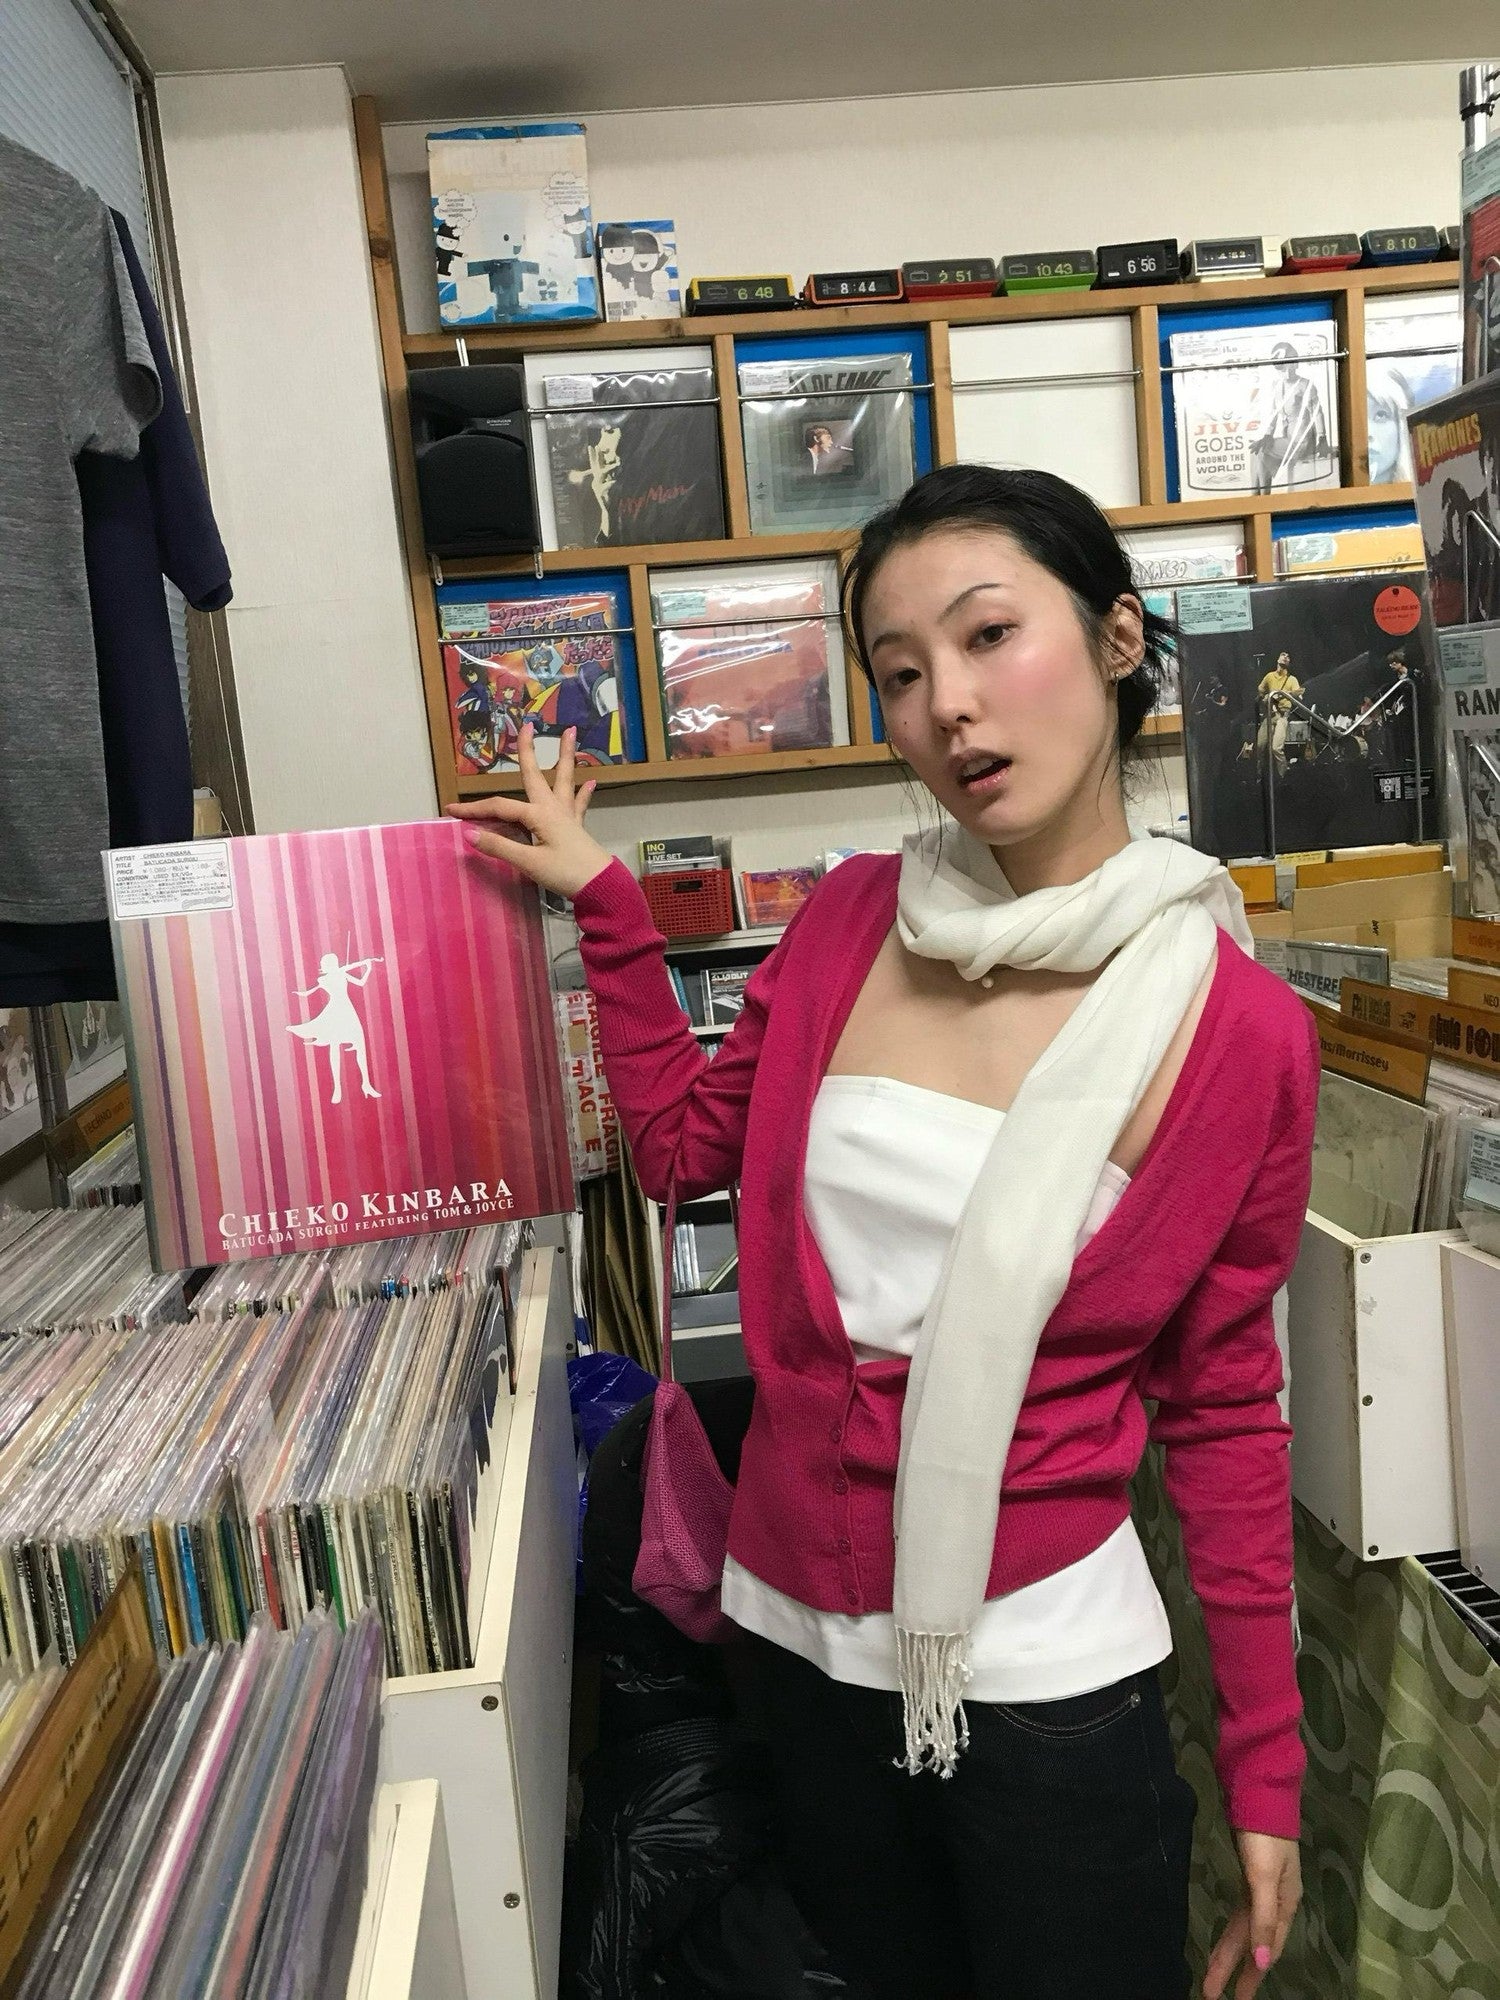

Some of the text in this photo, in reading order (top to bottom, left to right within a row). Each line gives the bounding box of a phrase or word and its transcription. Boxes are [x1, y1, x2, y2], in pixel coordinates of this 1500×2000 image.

[1194, 435, 1245, 454] GOES
[1417, 411, 1482, 469] RAMONES
[1196, 453, 1245, 465] AROUND THE
[1196, 463, 1246, 475] WORLD!
[646, 842, 666, 852] INO
[667, 852, 682, 861] SET
[117, 874, 149, 882] CONDITION
[218, 1178, 513, 1237] CHIEKO KINBARA
[222, 1197, 515, 1250] BATUCADA SURGIU FEATURING TOM & JOYCE
